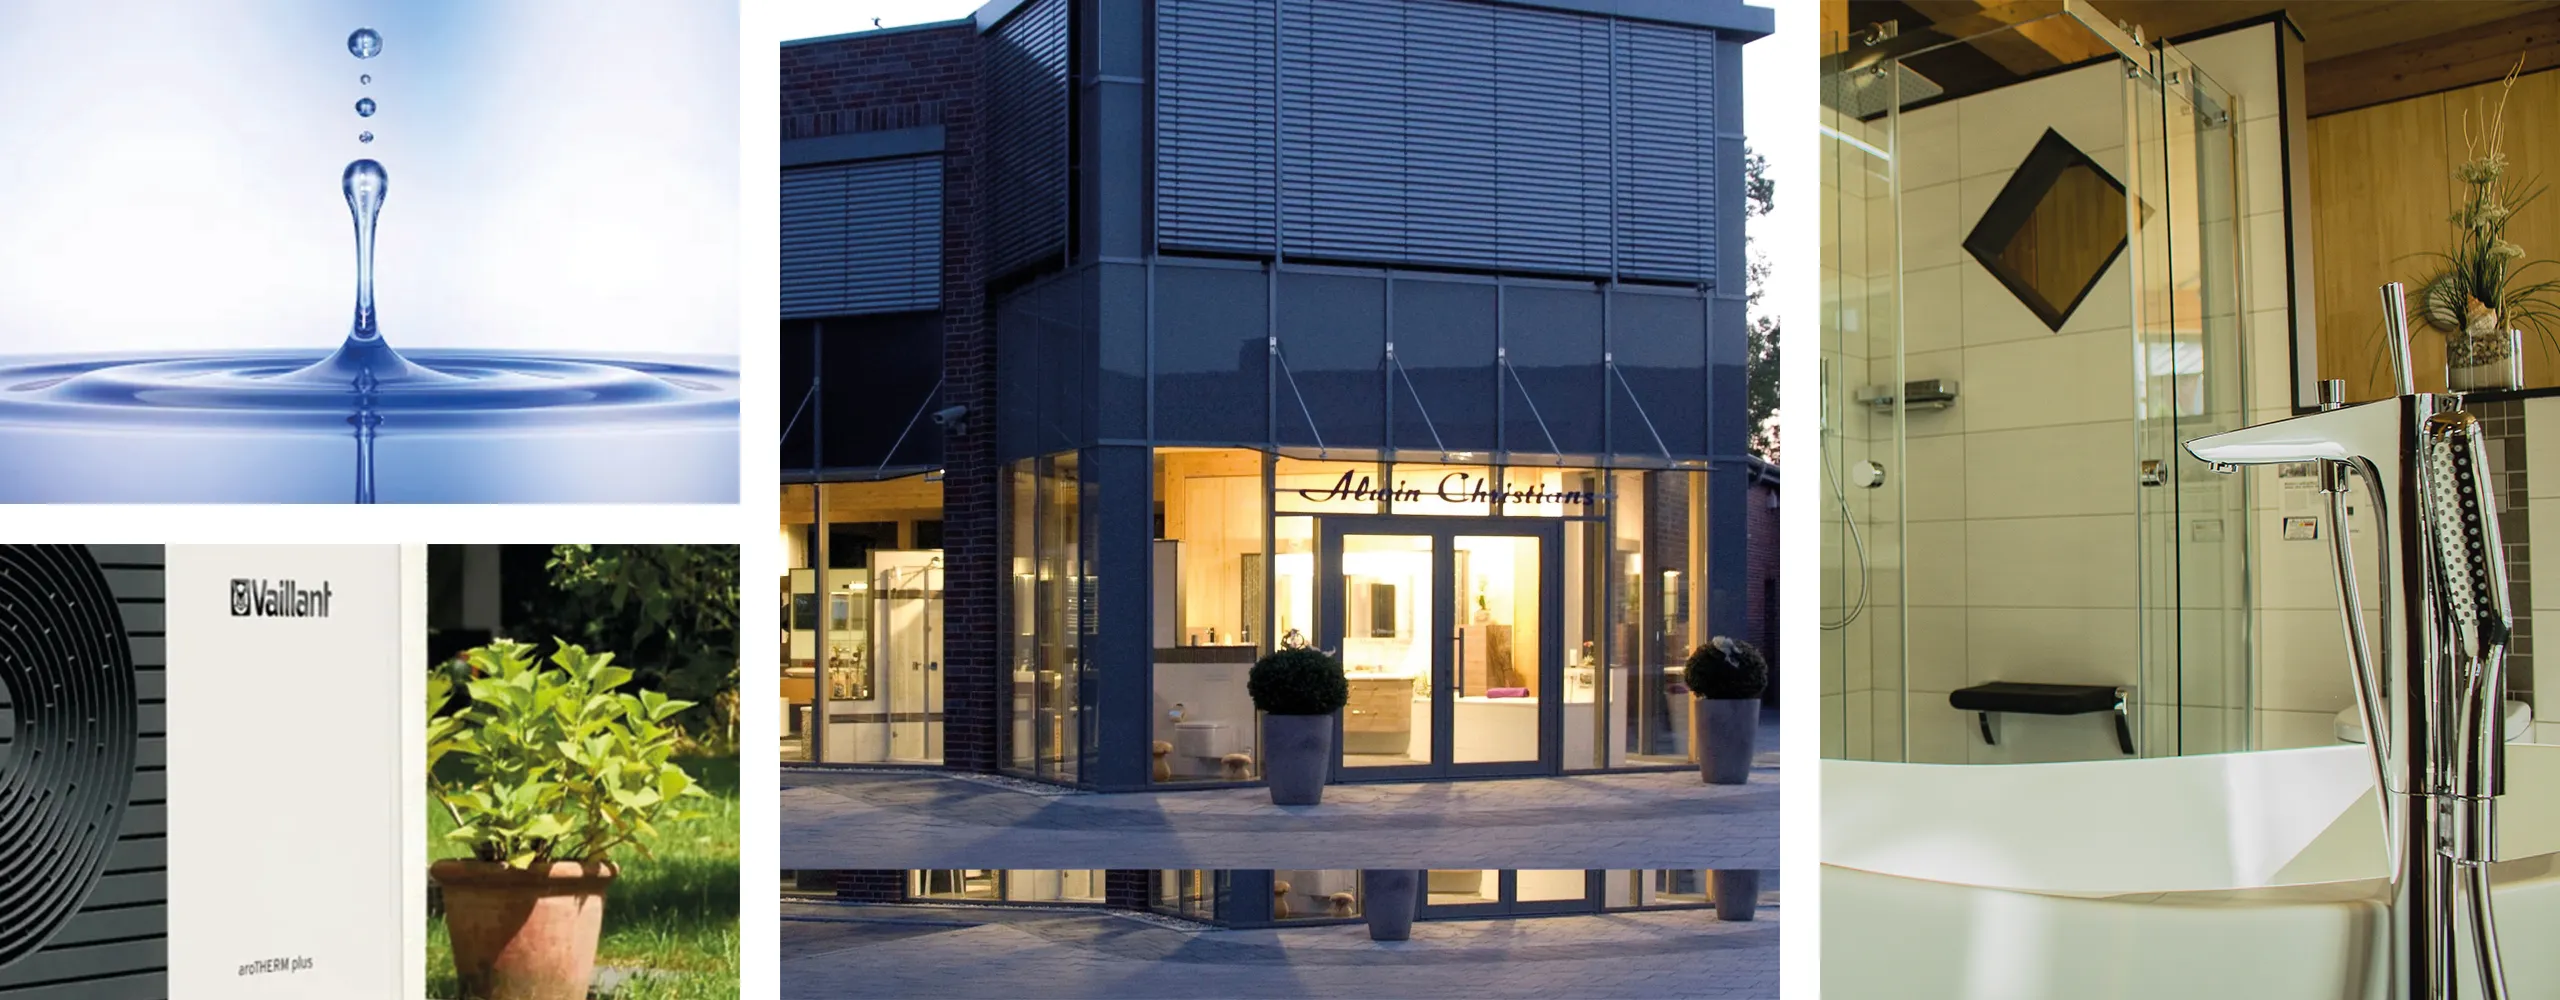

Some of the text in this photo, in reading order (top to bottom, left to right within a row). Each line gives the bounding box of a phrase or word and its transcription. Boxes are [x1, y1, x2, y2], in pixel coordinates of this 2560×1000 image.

[1299, 469, 1595, 505] Alwin Christians
[252, 579, 332, 617] Vaillant
[238, 955, 314, 976] aroTHERM plus
